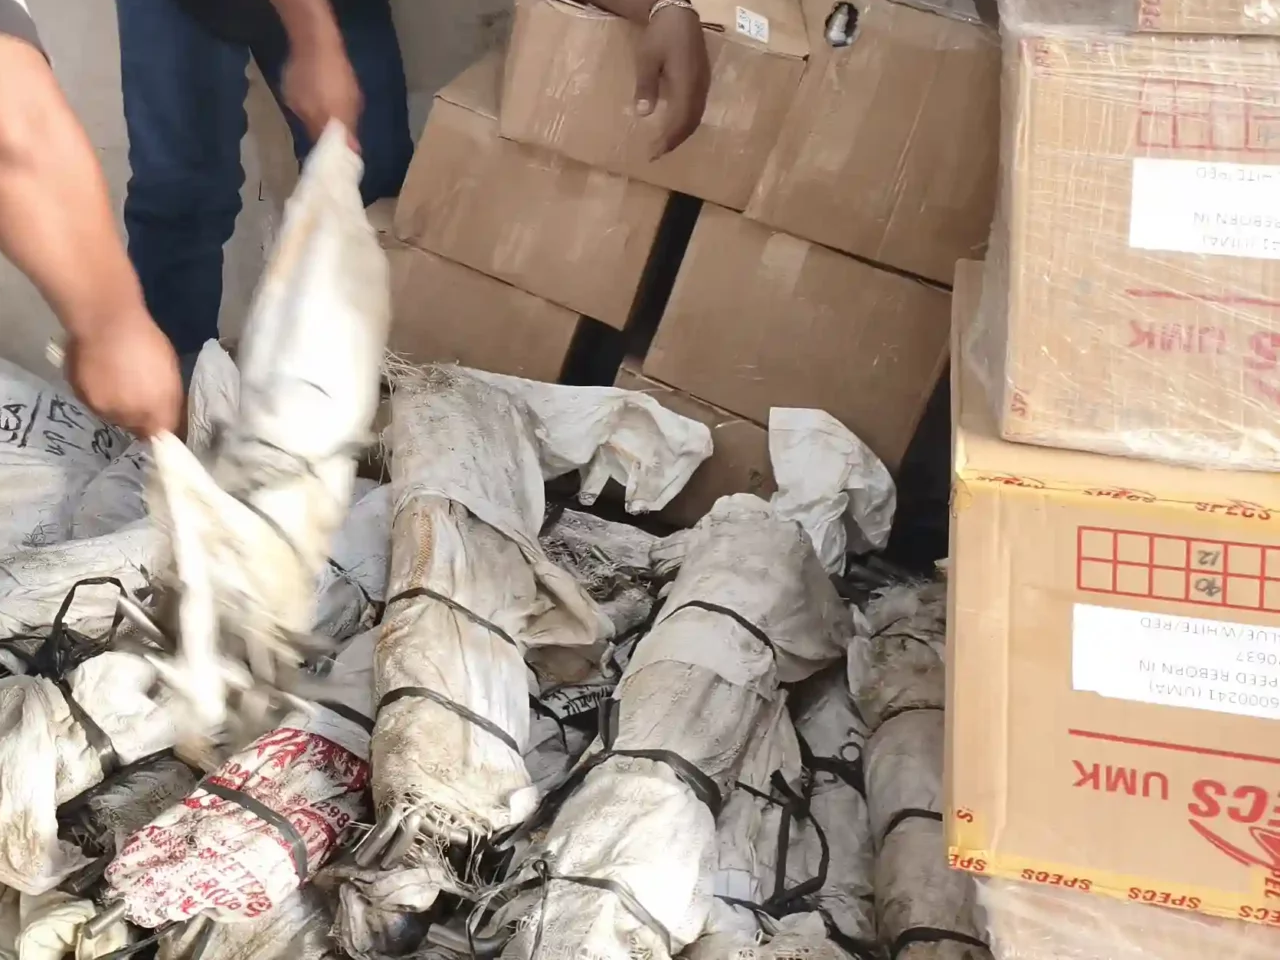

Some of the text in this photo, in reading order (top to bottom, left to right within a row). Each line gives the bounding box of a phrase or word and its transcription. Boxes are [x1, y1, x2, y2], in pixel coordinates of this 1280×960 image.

[1194, 500, 1272, 522] SPECS
[1140, 616, 1280, 644] LUE/WHITE/RED
[1236, 651, 1280, 666] 0637
[1139, 659, 1278, 689] PEED REBORN IN
[1072, 759, 1169, 801] UMK
[1021, 867, 1093, 891] SPECS
[1127, 887, 1202, 910] SPECS
[1238, 904, 1280, 927] ECS
